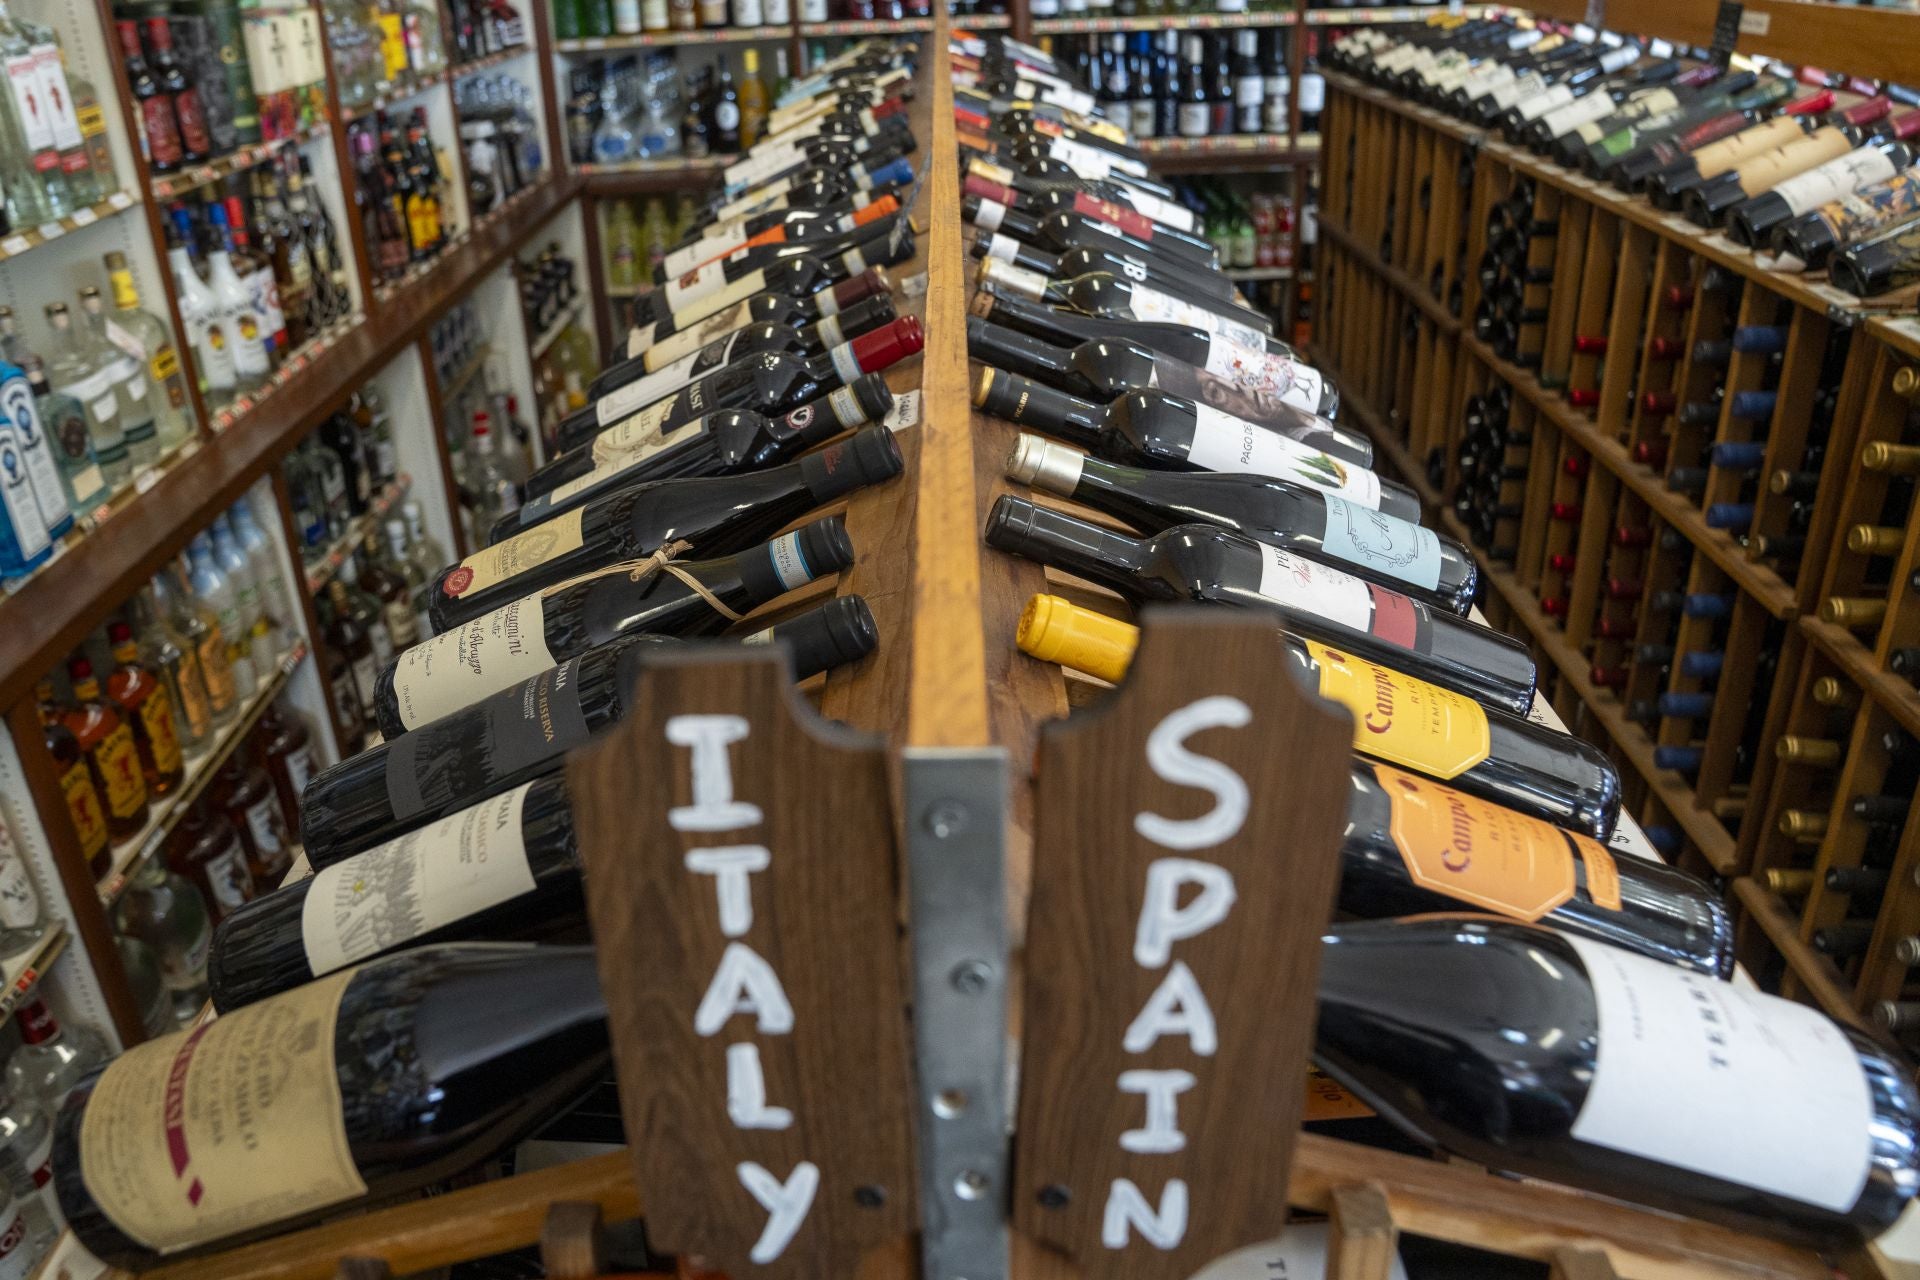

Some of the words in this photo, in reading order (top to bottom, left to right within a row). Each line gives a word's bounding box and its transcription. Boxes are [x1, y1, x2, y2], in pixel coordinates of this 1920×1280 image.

[1240, 437, 1254, 465] PAGO
[1406, 680, 1420, 705] RIO
[539, 697, 555, 742] RISERVA
[665, 713, 820, 1264] ITALY
[1101, 695, 1252, 1250] SPAIN
